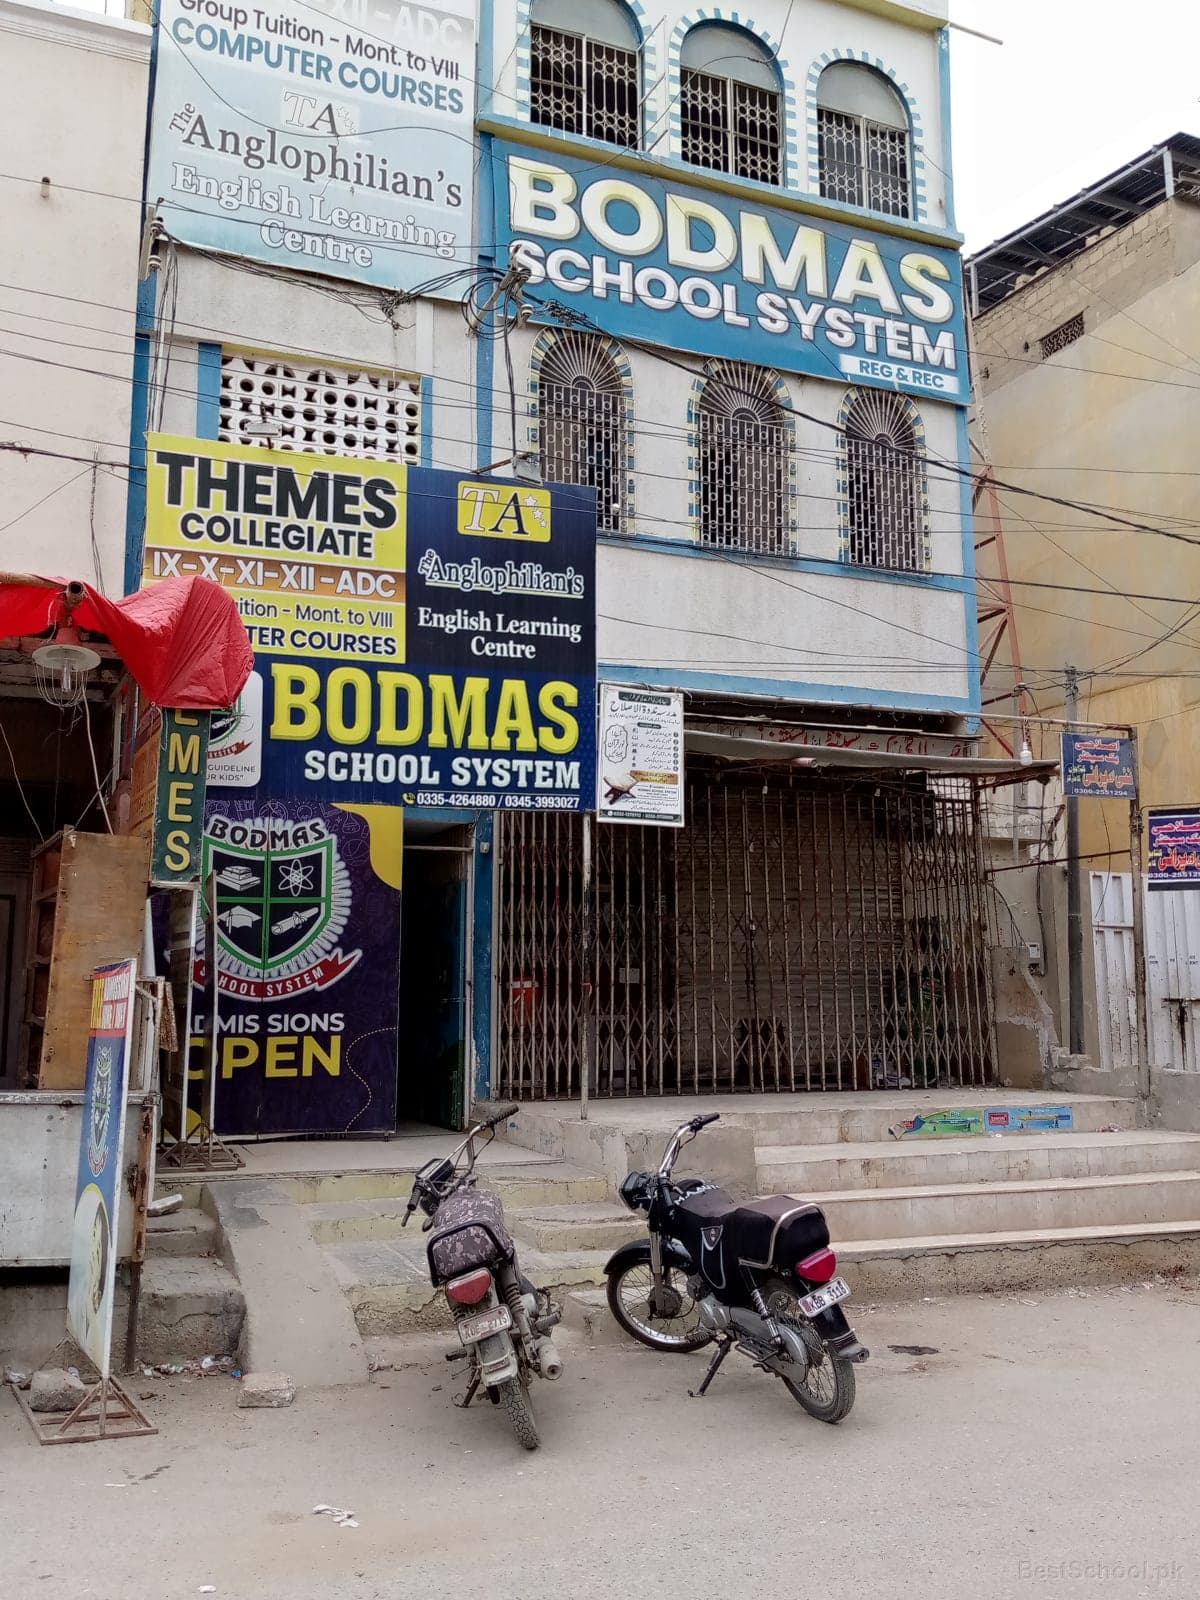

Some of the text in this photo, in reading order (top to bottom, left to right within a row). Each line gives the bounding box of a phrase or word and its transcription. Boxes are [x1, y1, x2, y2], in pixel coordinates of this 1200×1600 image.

[172, 17, 464, 114] COMPUTER COURSES
[253, 9, 324, 46] Tuition
[345, 34, 401, 66] Mont.
[406, 50, 426, 72] to
[431, 57, 460, 81] VIII
[284, 91, 339, 137] TA
[169, 102, 462, 208] The Anglophilian's
[171, 162, 457, 259] English Learning
[260, 217, 373, 267] Centre
[508, 154, 955, 324] BODMAS
[509, 238, 957, 370] SCHOOL SYSTEM
[859, 358, 945, 388] REG & REC
[156, 450, 397, 529] THEMES
[461, 486, 529, 535] TA
[180, 512, 373, 559] COLLEGIATE
[418, 548, 585, 595] The Anglophilian's
[235, 598, 277, 618] ition
[296, 604, 344, 623] Mont.
[348, 609, 364, 626] to
[368, 611, 393, 628] VIII
[417, 607, 582, 643] English Learning
[290, 629, 397, 656] COURSES
[470, 635, 536, 659] Centre
[270, 662, 580, 755] BODMAS
[207, 764, 256, 773] GUIDELINE
[304, 749, 580, 789] SCHOOL SYSTEM
[416, 792, 496, 806] 0335-4264880
[505, 796, 580, 809] 0345-3993027
[209, 818, 326, 848] BODMAS
[266, 966, 324, 996] SYSTEM
